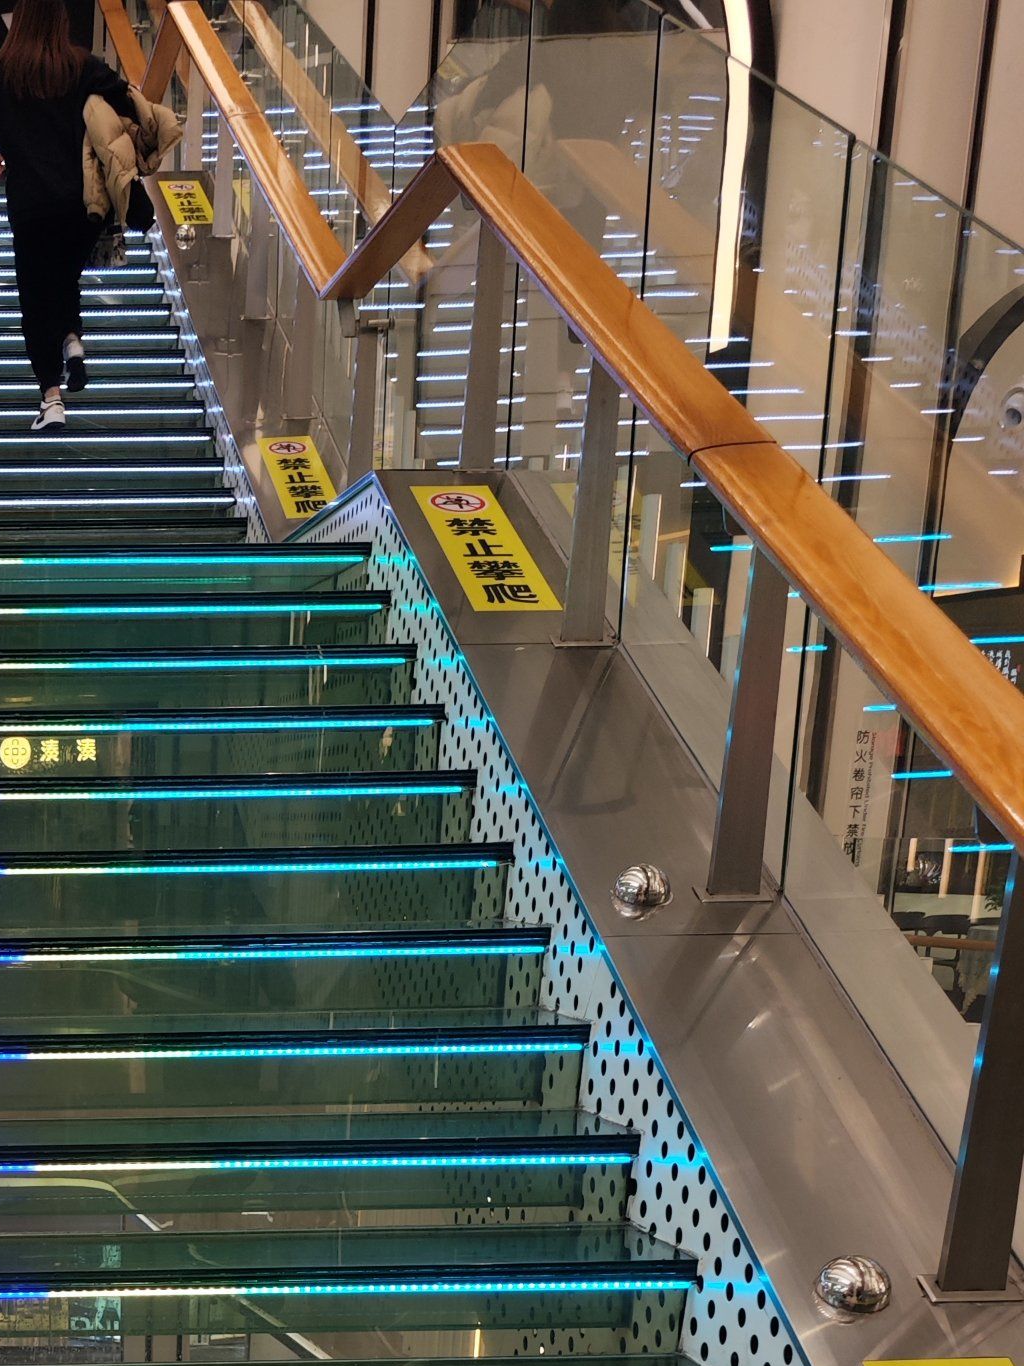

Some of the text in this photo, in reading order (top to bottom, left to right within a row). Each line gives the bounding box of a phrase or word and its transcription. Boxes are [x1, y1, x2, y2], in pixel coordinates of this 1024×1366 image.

[173, 193, 208, 221] 禁止攀爬
[276, 457, 328, 513] 禁止攀爬
[445, 518, 539, 604] 禁止攀爬
